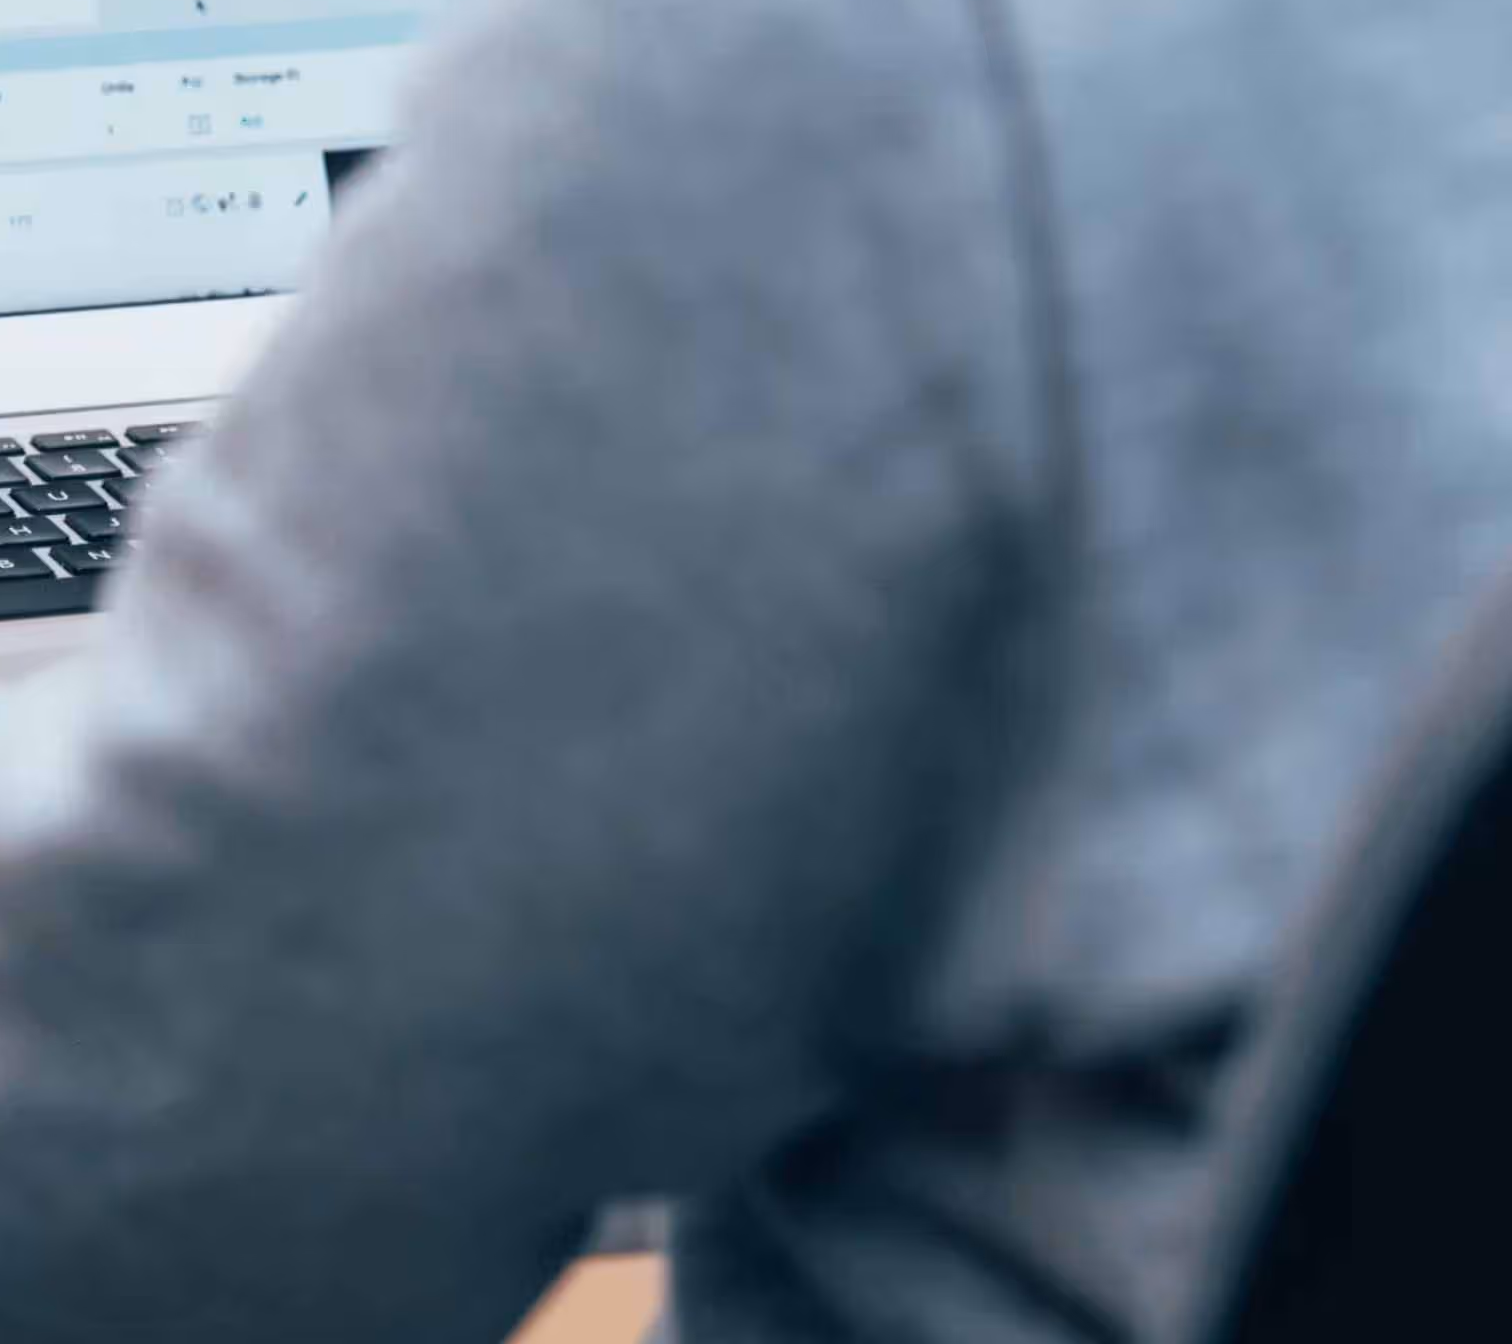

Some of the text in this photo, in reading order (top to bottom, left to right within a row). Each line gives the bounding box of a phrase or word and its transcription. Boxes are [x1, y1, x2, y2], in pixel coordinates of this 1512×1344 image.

[47, 490, 69, 502] U
[8, 523, 33, 536] H
[88, 548, 112, 562] N
